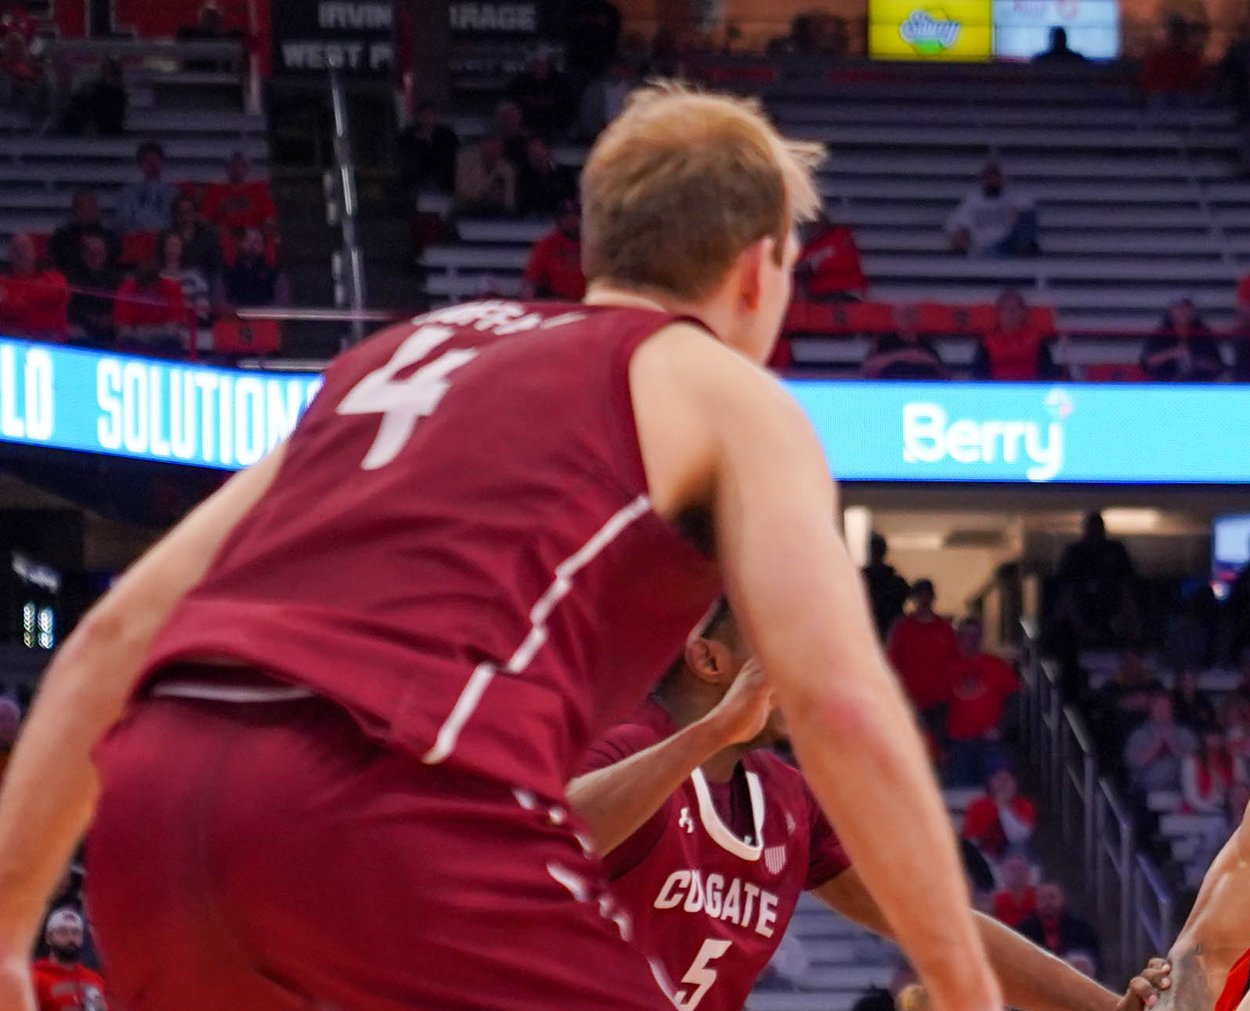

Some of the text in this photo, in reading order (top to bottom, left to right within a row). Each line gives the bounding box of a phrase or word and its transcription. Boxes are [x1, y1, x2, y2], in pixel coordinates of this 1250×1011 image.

[0, 345, 324, 466] LD SOLUTION
[336, 325, 478, 470] 4
[902, 402, 1064, 482] Berry
[653, 869, 779, 938] COGATE
